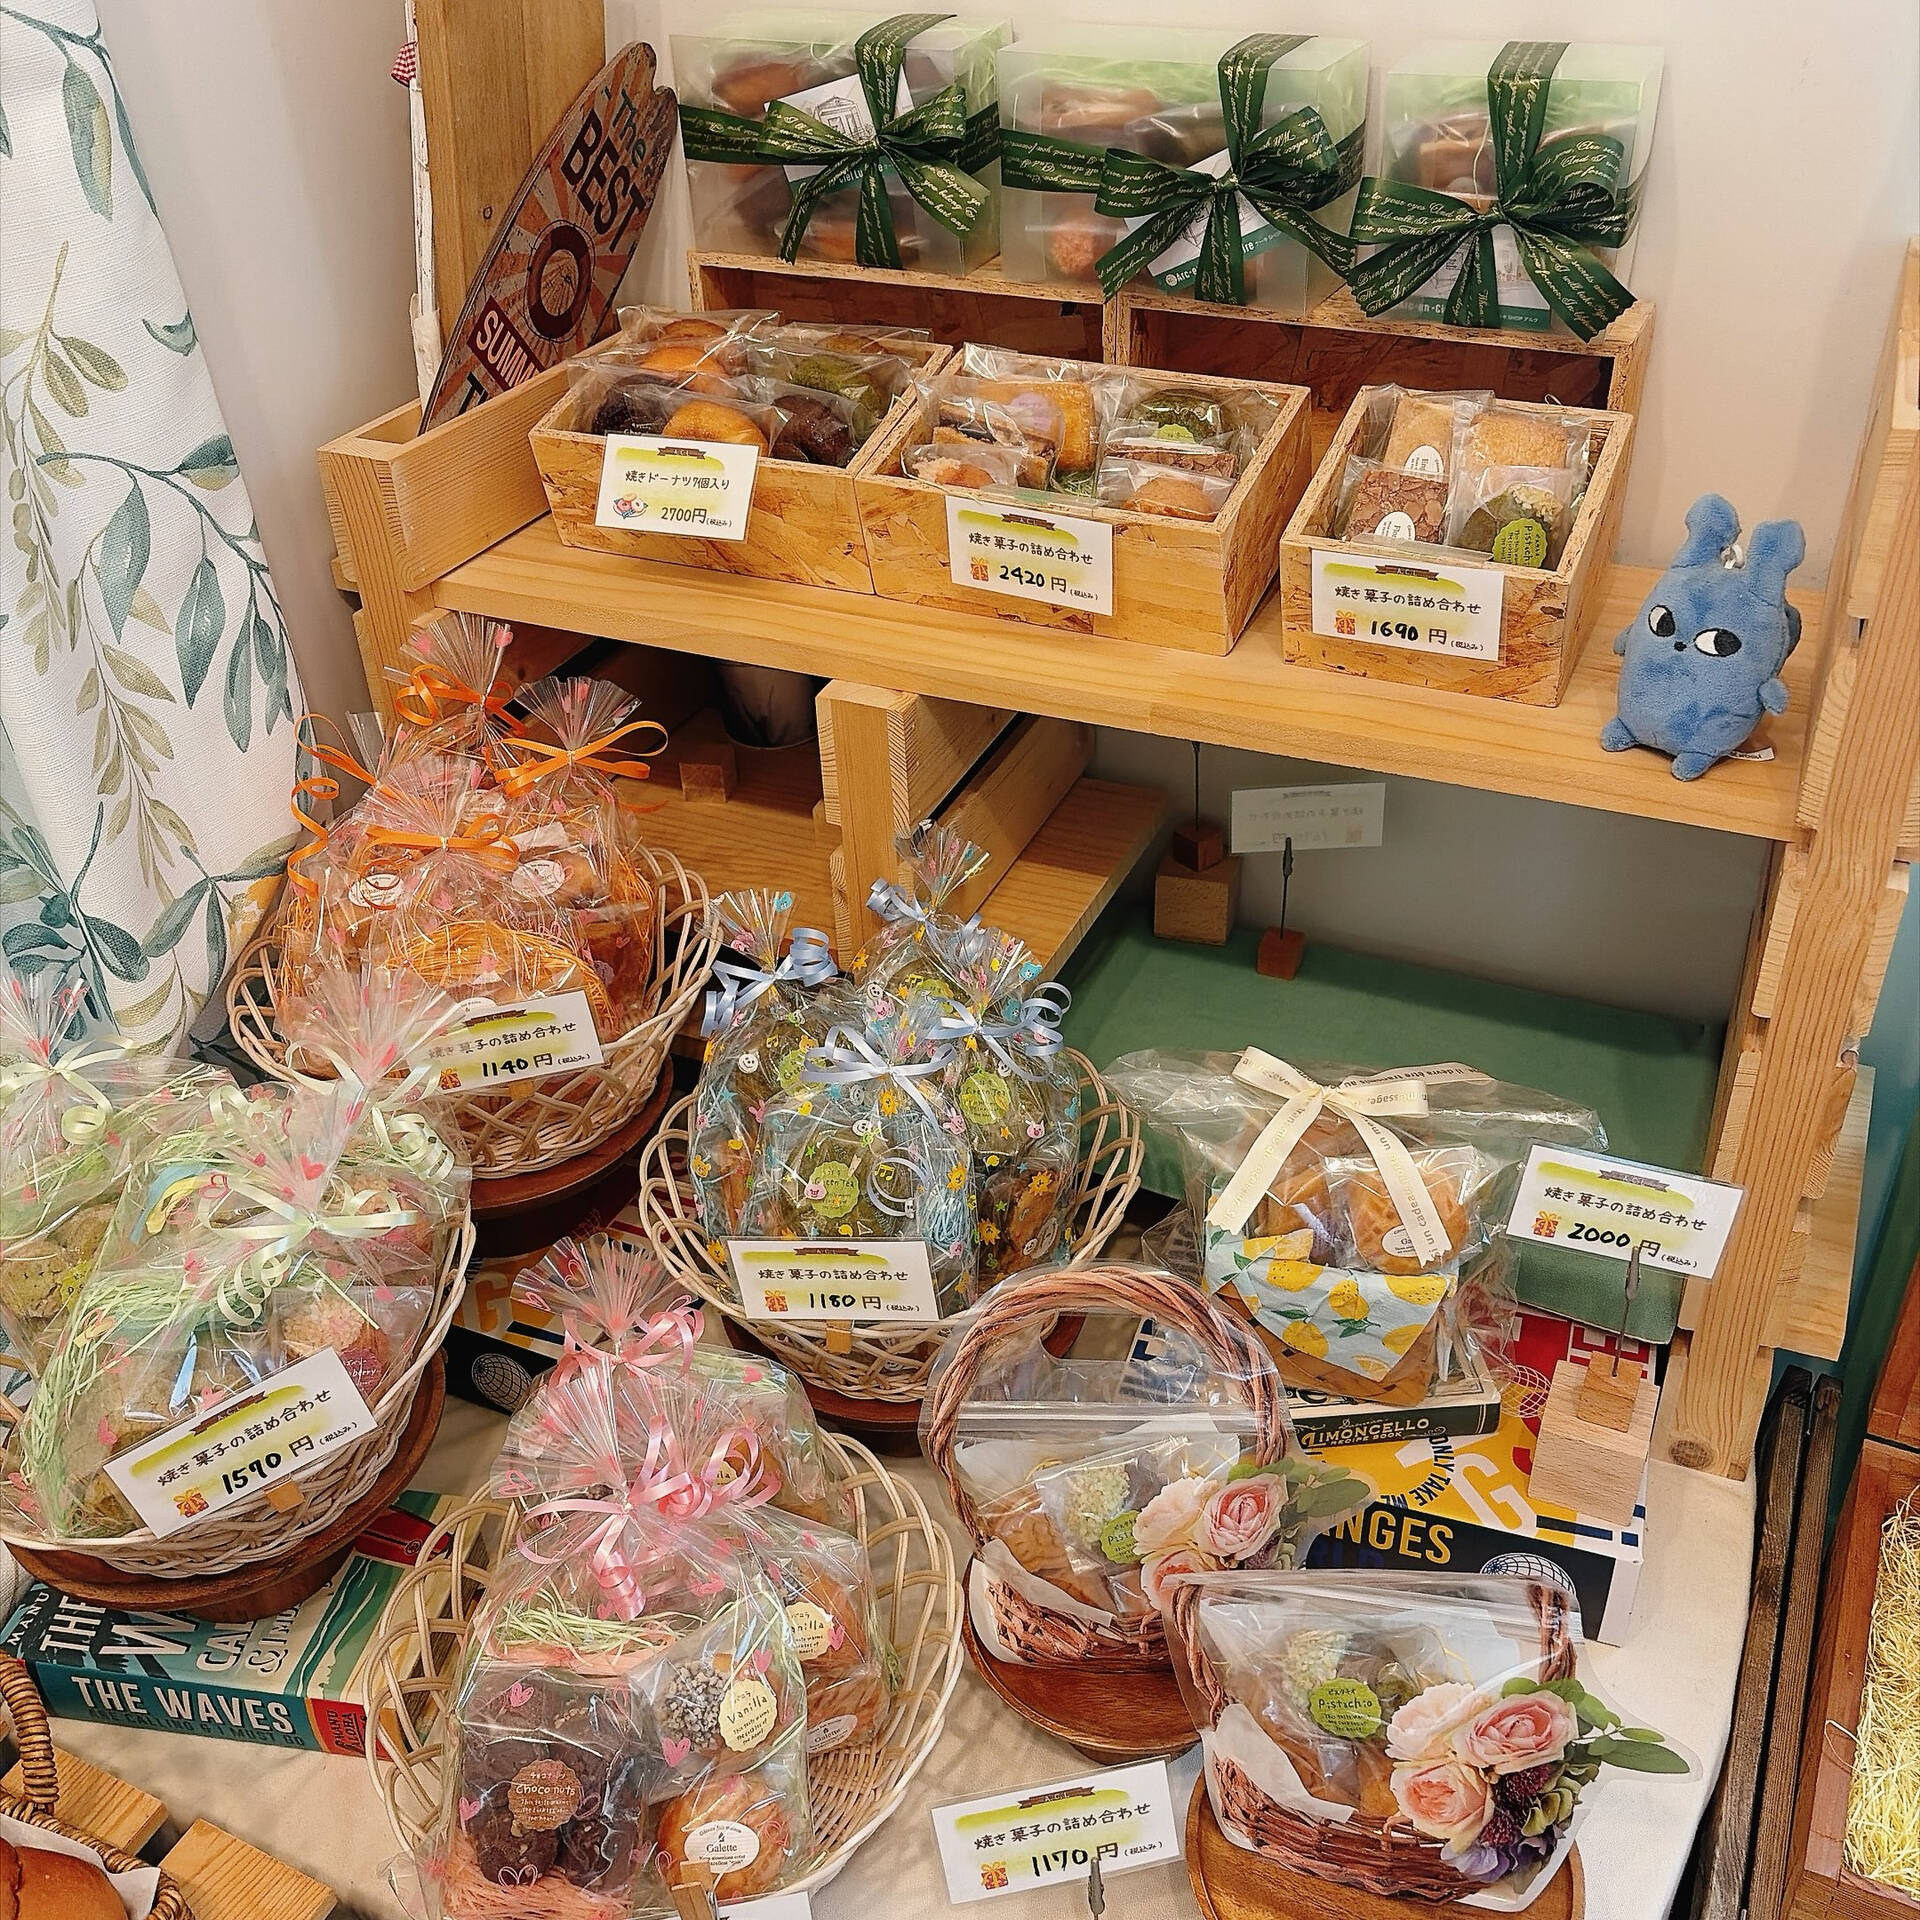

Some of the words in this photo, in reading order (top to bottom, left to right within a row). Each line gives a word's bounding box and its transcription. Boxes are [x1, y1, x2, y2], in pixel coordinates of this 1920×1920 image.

[560, 108, 646, 254] BEST
[1301, 1418, 1430, 1448] LIMONCELLO
[1373, 1431, 1402, 1441] BOOK
[1429, 1437, 1455, 1473] ONLY
[1408, 1471, 1451, 1506] TAKE
[9, 1591, 50, 1647] MANU
[71, 1676, 149, 1715] THE
[154, 1686, 297, 1735] WAVES
[727, 1695, 768, 1724] Vanilla
[1318, 1697, 1373, 1709] Pistachio
[515, 1784, 551, 1795] Choco
[553, 1784, 576, 1797] nuts
[973, 1803, 1151, 1850] 焼き菓子の詰め合わせ
[706, 1844, 738, 1853] Galette
